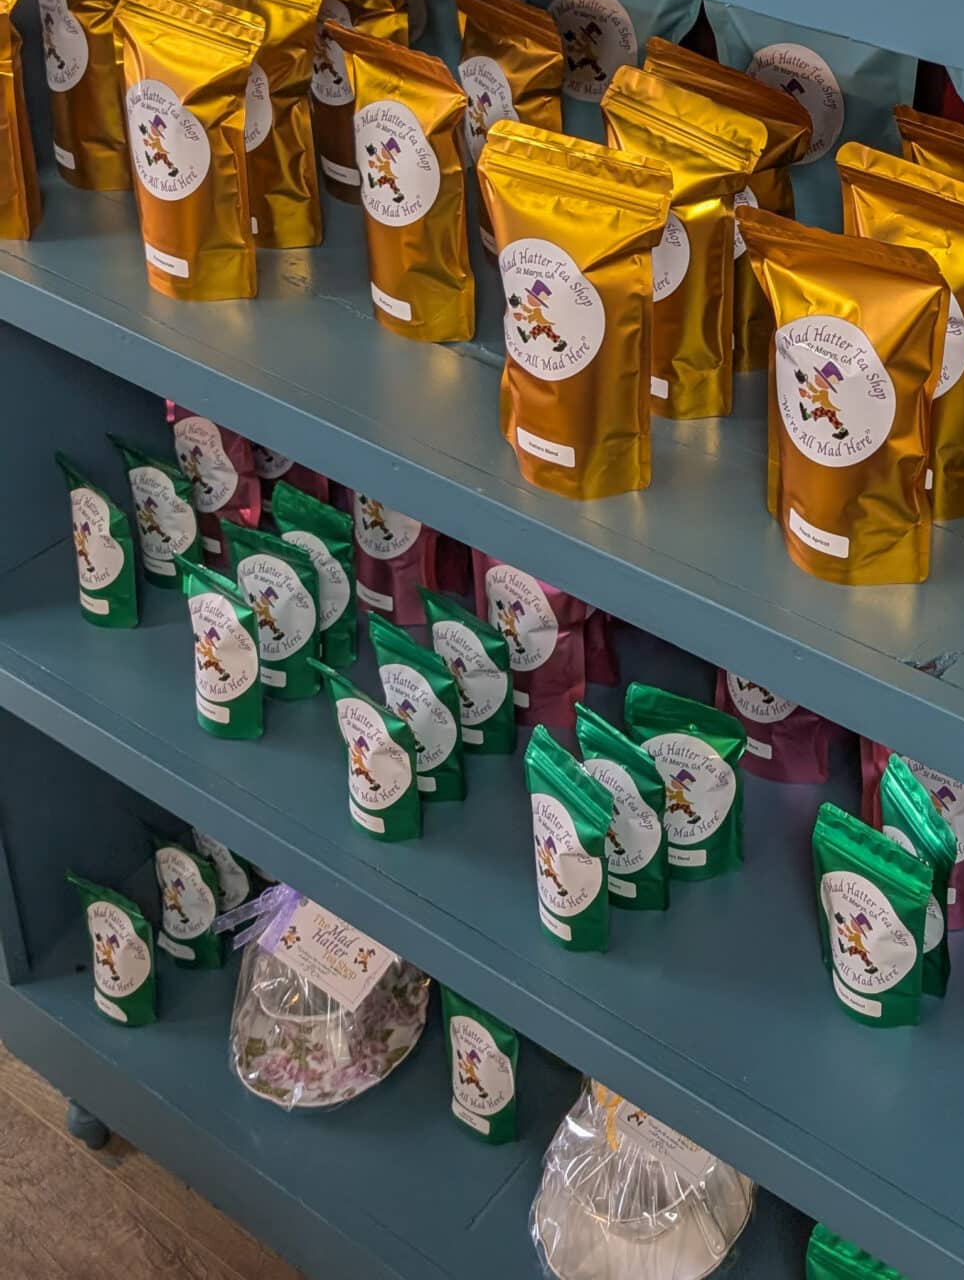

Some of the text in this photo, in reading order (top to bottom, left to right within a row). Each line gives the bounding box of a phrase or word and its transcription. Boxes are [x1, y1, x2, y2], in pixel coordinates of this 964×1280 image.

[380, 109, 433, 173] Hatter Tea Shop
[520, 248, 593, 308] Hatter Tea Shop
[783, 328, 887, 400] Mad Hatter Tea Shop
[667, 744, 699, 763] Hatter
[846, 882, 891, 929] Hatter Tea
[312, 928, 348, 957] Hatter
[328, 925, 360, 949] Mad
